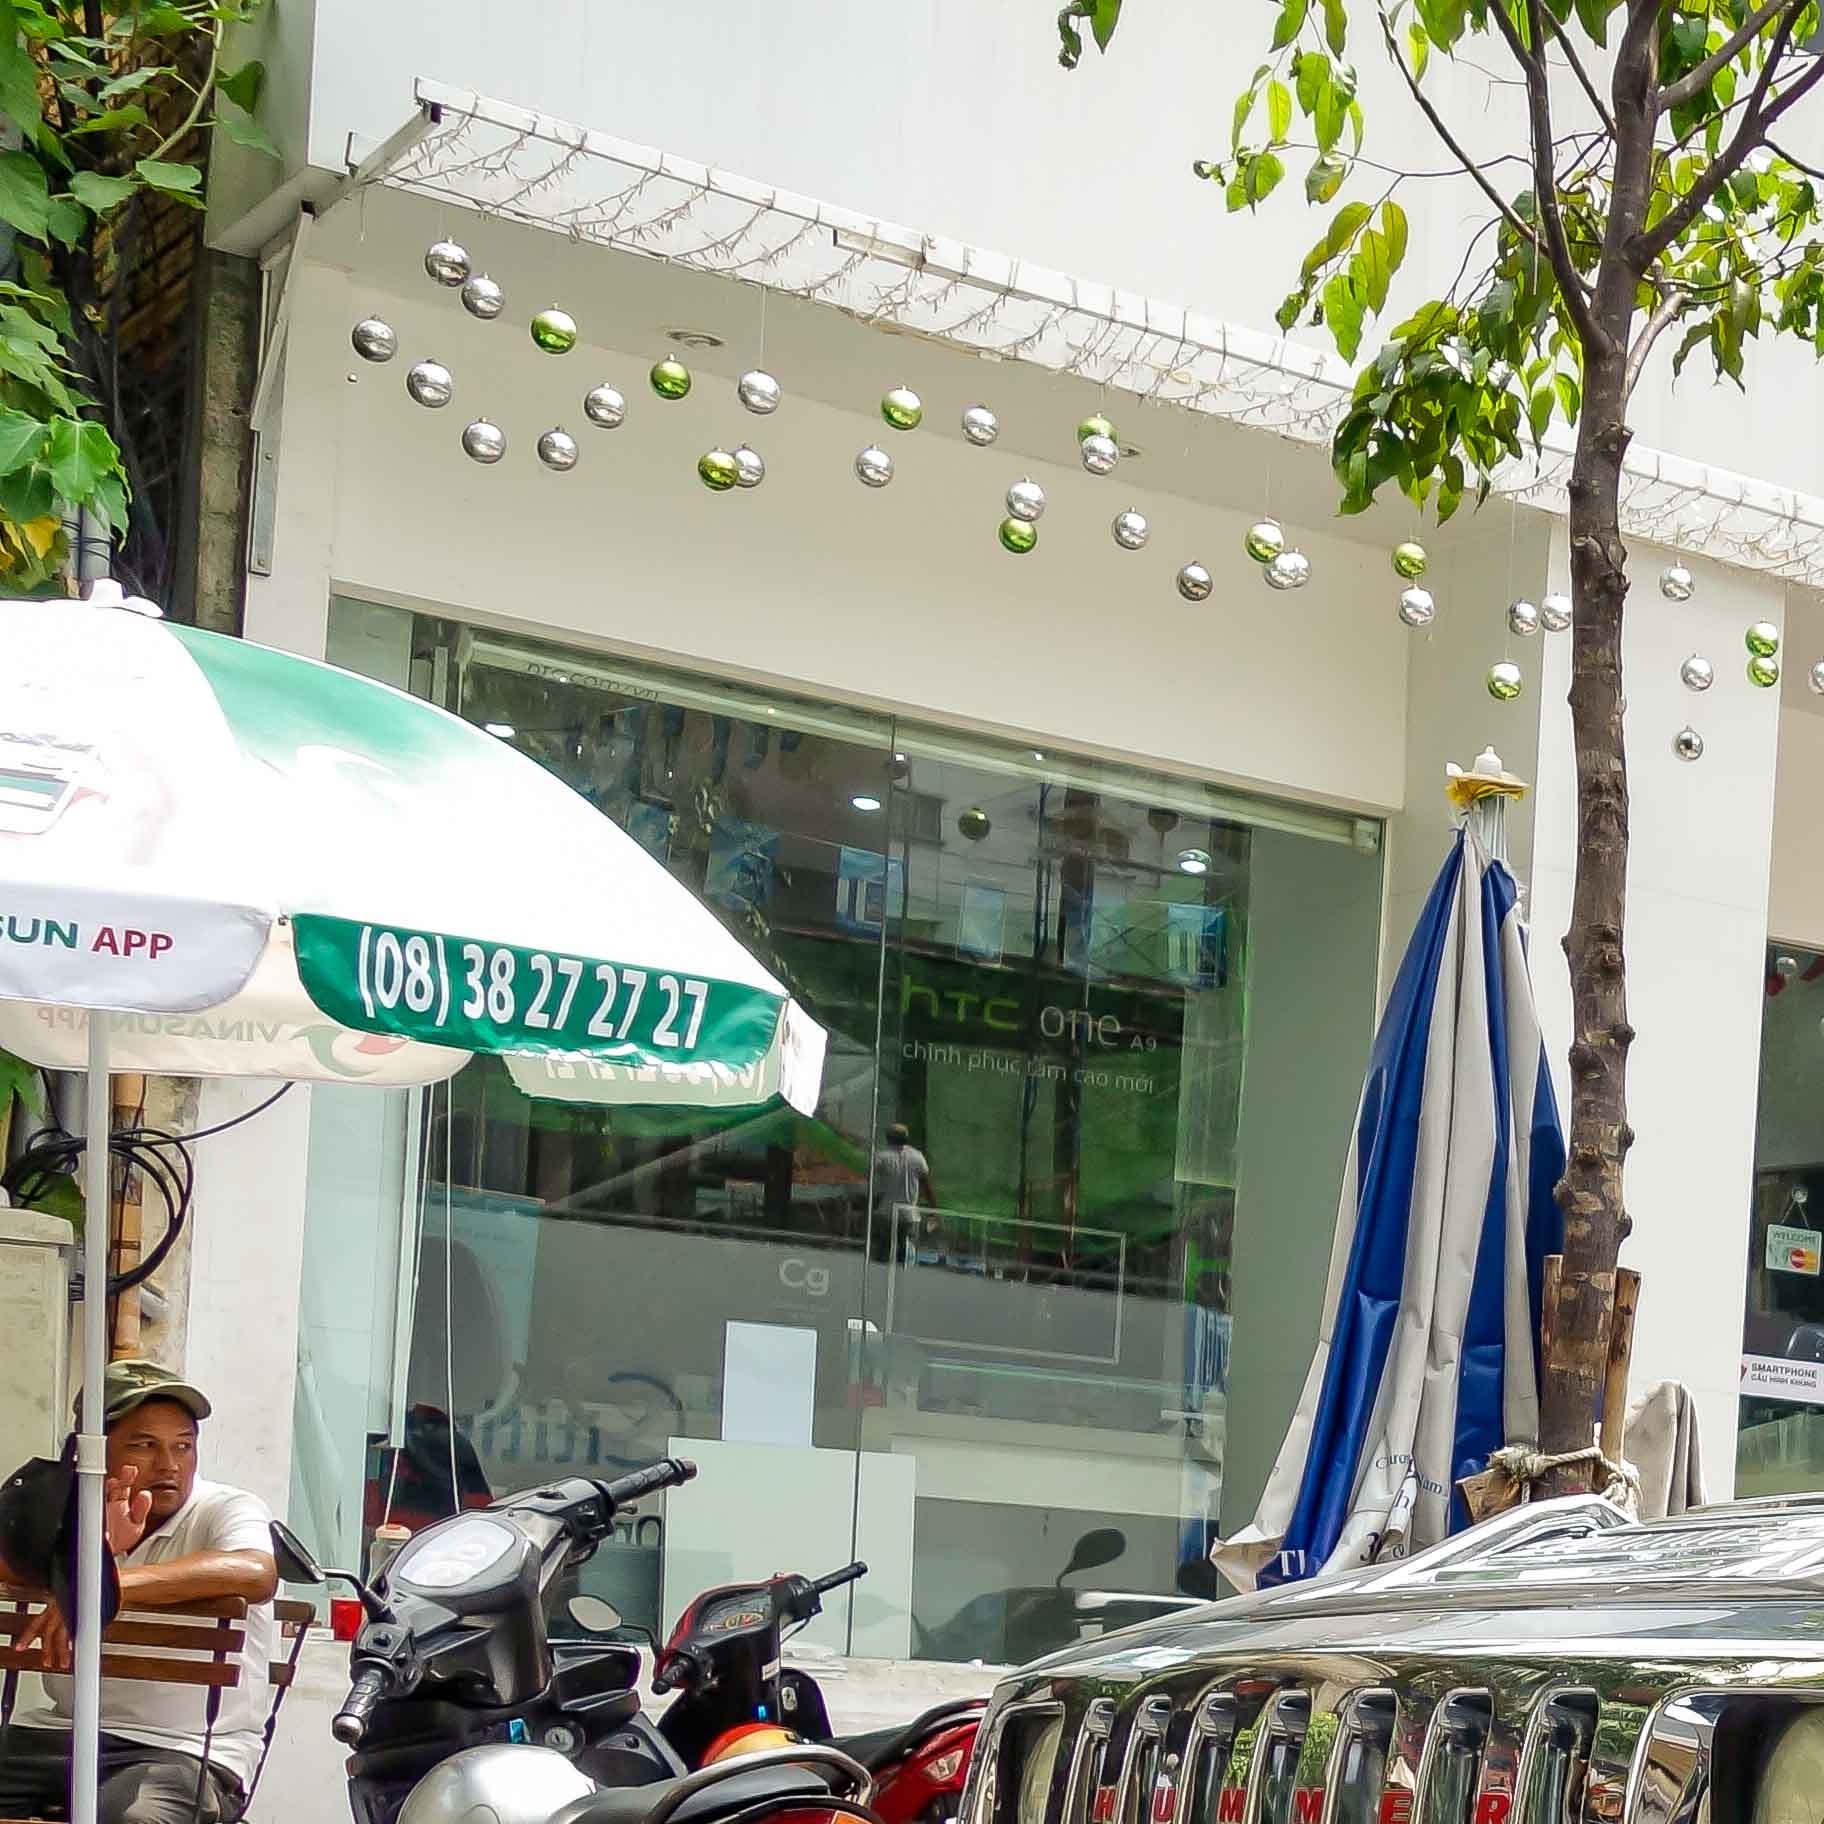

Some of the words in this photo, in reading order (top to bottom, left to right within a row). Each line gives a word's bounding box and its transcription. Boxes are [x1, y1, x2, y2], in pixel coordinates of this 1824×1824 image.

[0, 915, 78, 949] UN
[92, 926, 174, 959] APP
[358, 926, 449, 1027] (08)
[462, 943, 515, 1024] 38
[524, 953, 583, 1030] 27
[587, 964, 647, 1039] 27
[652, 974, 708, 1049] 27
